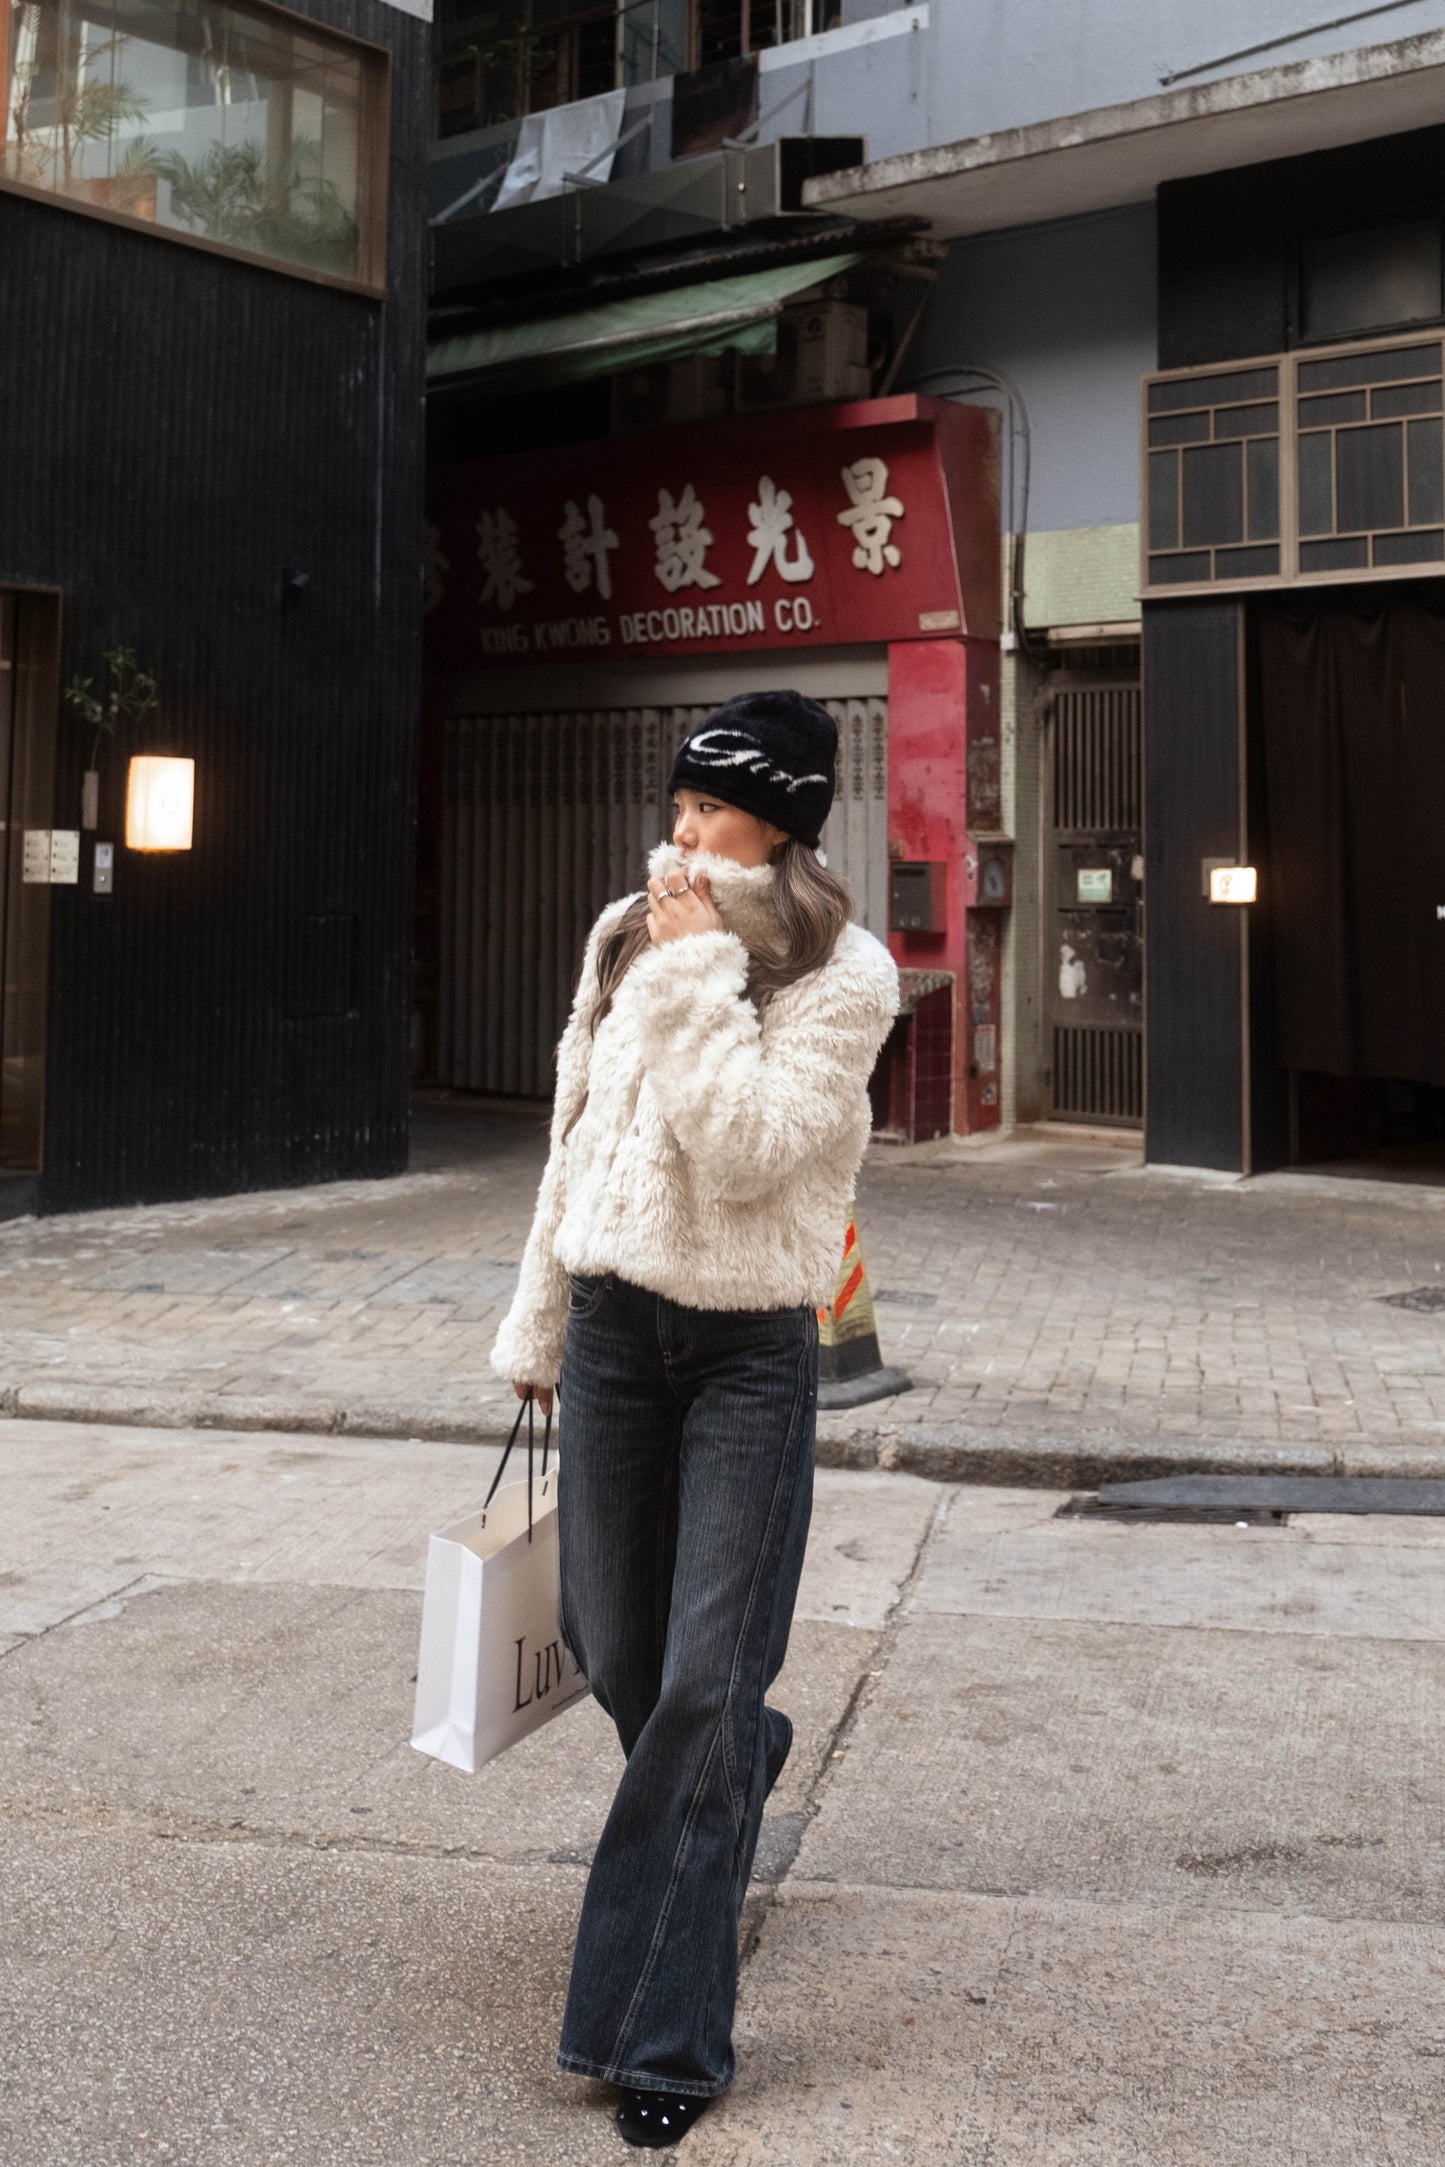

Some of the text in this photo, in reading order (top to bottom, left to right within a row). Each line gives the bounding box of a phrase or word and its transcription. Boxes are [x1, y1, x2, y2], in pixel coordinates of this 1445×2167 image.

[481, 597, 821, 655] KING KWONG DECORATION CO.
